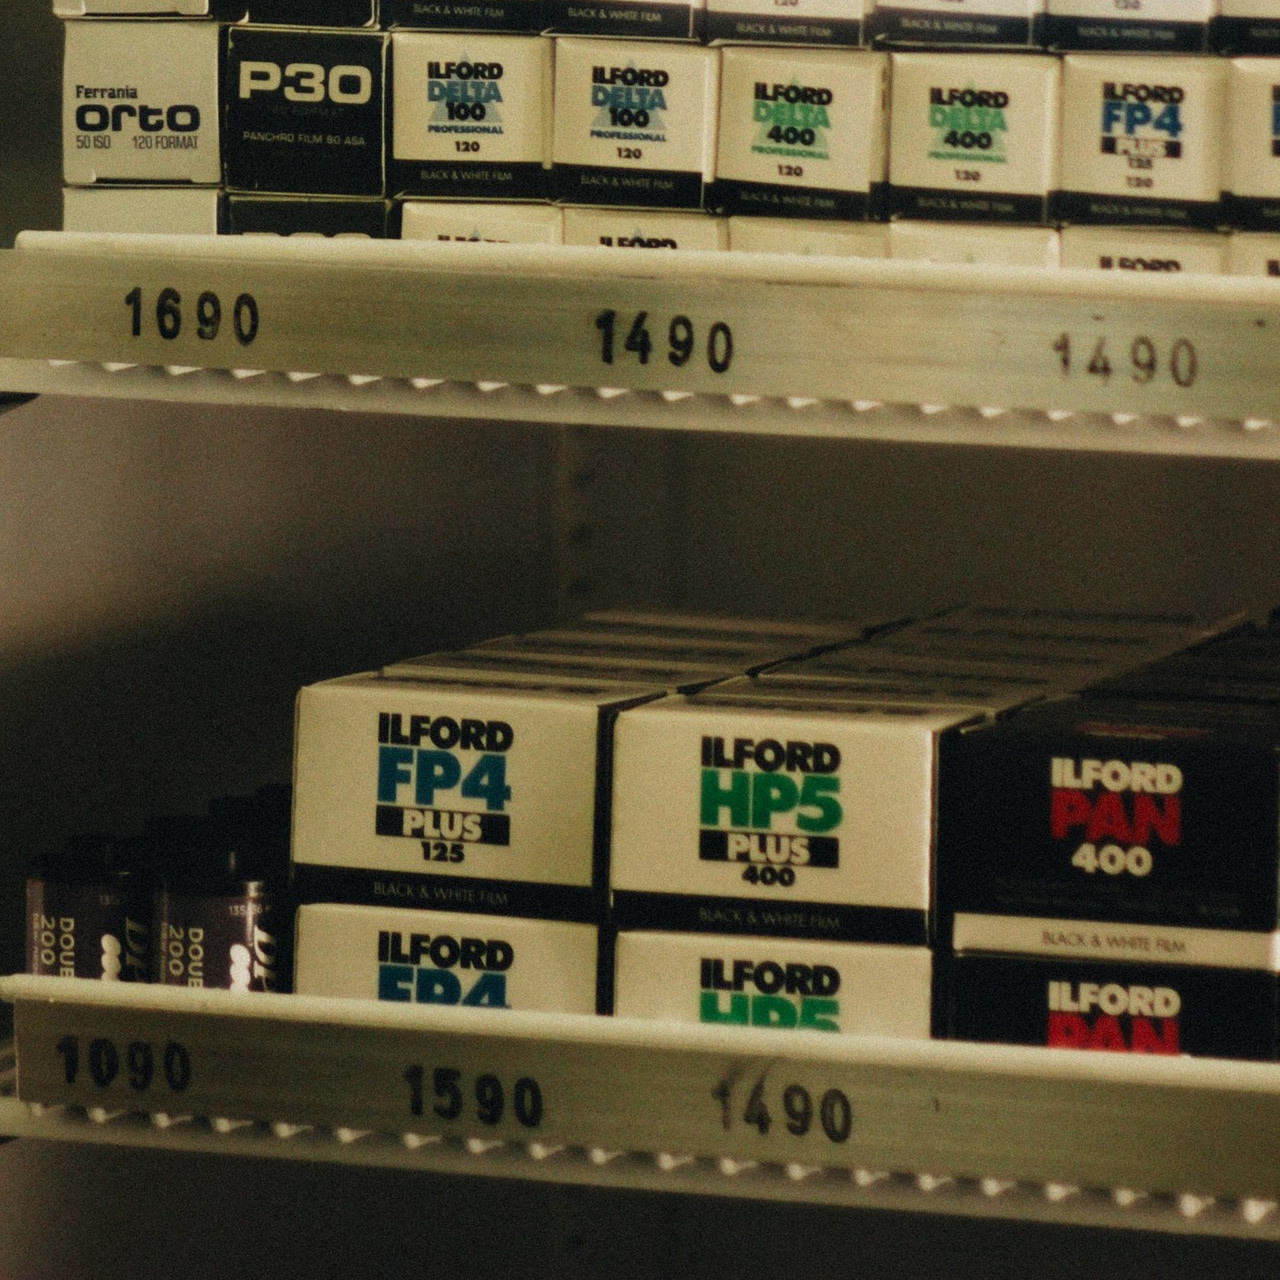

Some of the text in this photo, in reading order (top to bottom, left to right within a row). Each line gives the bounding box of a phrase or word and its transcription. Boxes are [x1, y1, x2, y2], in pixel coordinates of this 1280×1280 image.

[239, 61, 372, 105] P30
[427, 61, 503, 80] ILFORD
[592, 66, 669, 87] ILFORD
[76, 85, 137, 99] Ferrania
[427, 81, 503, 103] DELTA
[591, 85, 667, 111] DELTA
[754, 82, 833, 106] ILFORD
[929, 87, 1009, 109] ILFORD
[1103, 82, 1184, 104] ILFORD
[76, 105, 200, 132] orto
[446, 102, 486, 121] 100
[609, 107, 650, 128] 100
[753, 100, 831, 128] DELTA
[929, 105, 1008, 131] DELTA
[1102, 100, 1183, 138] FP4
[77, 136, 198, 149] 50 ISO 120 FORMAT
[243, 131, 294, 142] PANCHRO
[298, 133, 323, 143] FILM
[345, 136, 366, 146] ASA
[428, 124, 504, 135] PROFESSIONAL
[590, 130, 667, 142] PROFESSIONAL
[767, 125, 815, 146] 400
[944, 130, 993, 150] 400
[455, 141, 480, 152] 120
[617, 147, 641, 160] 120
[778, 164, 803, 177] 120
[955, 170, 980, 181] 120
[125, 287, 259, 346] 1690
[595, 308, 733, 373] 1490
[1053, 332, 1198, 387] 1490
[378, 712, 514, 753] ILFORD
[701, 736, 841, 774] ILFORD
[377, 746, 511, 812] FP4
[1051, 757, 1183, 795] ILFORD
[700, 769, 843, 834] HP5
[402, 808, 482, 840] PLUS
[1050, 787, 1182, 847] PAN
[421, 842, 465, 863] 125
[727, 834, 811, 865] PLUS
[1071, 843, 1153, 876] 400
[742, 865, 796, 887] 400
[41, 914, 55, 965] 200
[169, 925, 184, 977] 200
[378, 930, 514, 972] ILFORD
[700, 958, 841, 997] ILFORD
[1048, 981, 1182, 1018] ILFORD
[57, 1037, 191, 1092] 1090
[403, 1064, 543, 1128] 1590
[712, 1079, 853, 1143] 1490
